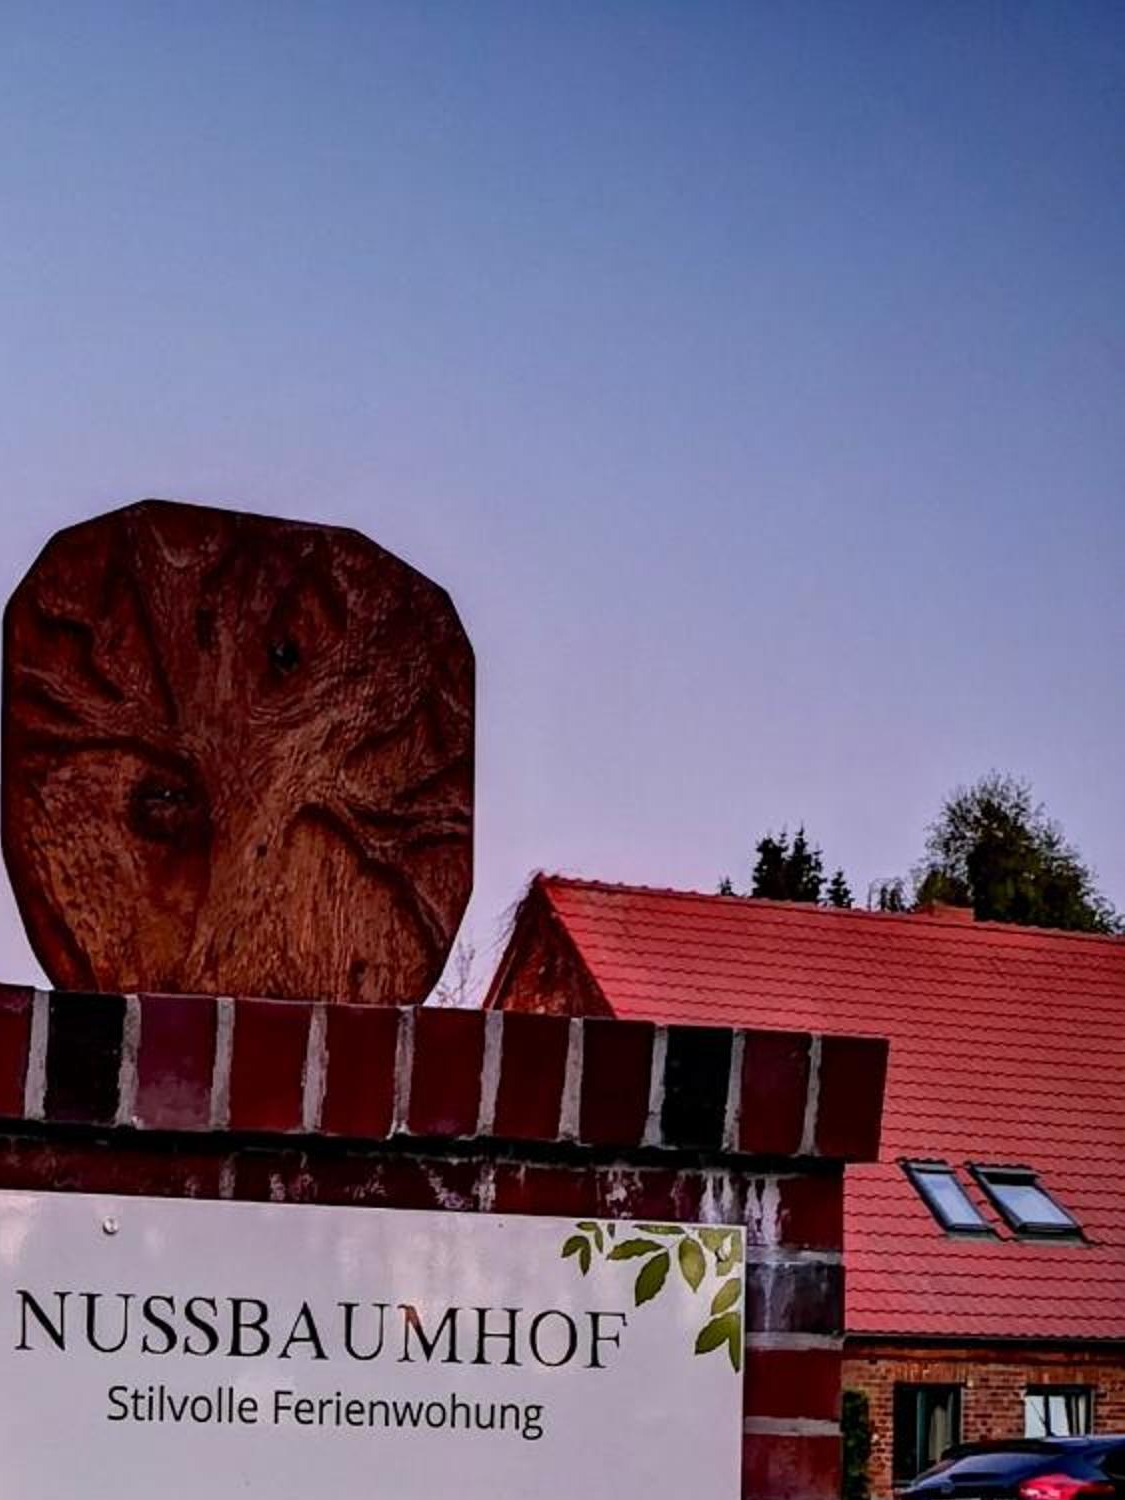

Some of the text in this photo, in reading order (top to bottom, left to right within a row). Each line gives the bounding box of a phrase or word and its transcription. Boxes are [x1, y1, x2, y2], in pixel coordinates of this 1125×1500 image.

[15, 1290, 627, 1368] NUSSBAUMHOF
[107, 1385, 544, 1440] Stilvolle Ferienwohung
